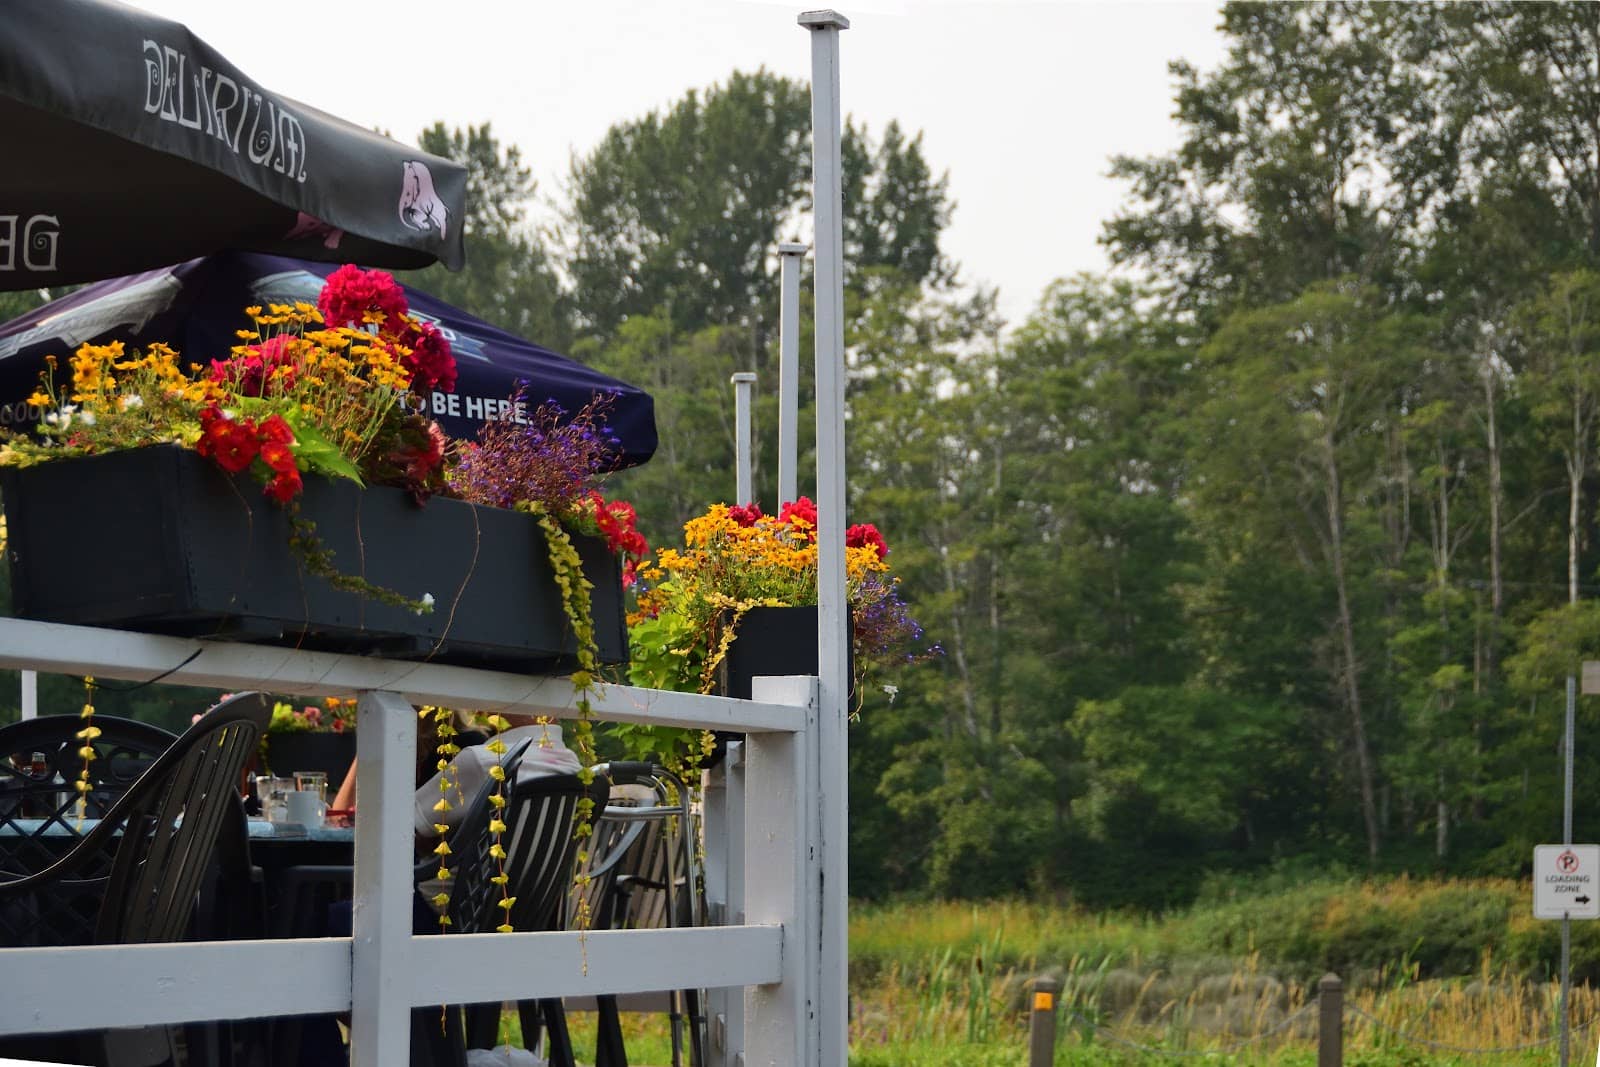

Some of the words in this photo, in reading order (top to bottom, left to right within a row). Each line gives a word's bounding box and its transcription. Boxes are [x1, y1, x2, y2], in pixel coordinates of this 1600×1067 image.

[143, 38, 307, 184] DELIRIUM
[431, 391, 461, 417] BE
[1545, 874, 1590, 883] LOADING
[1554, 884, 1581, 893] ZONE
